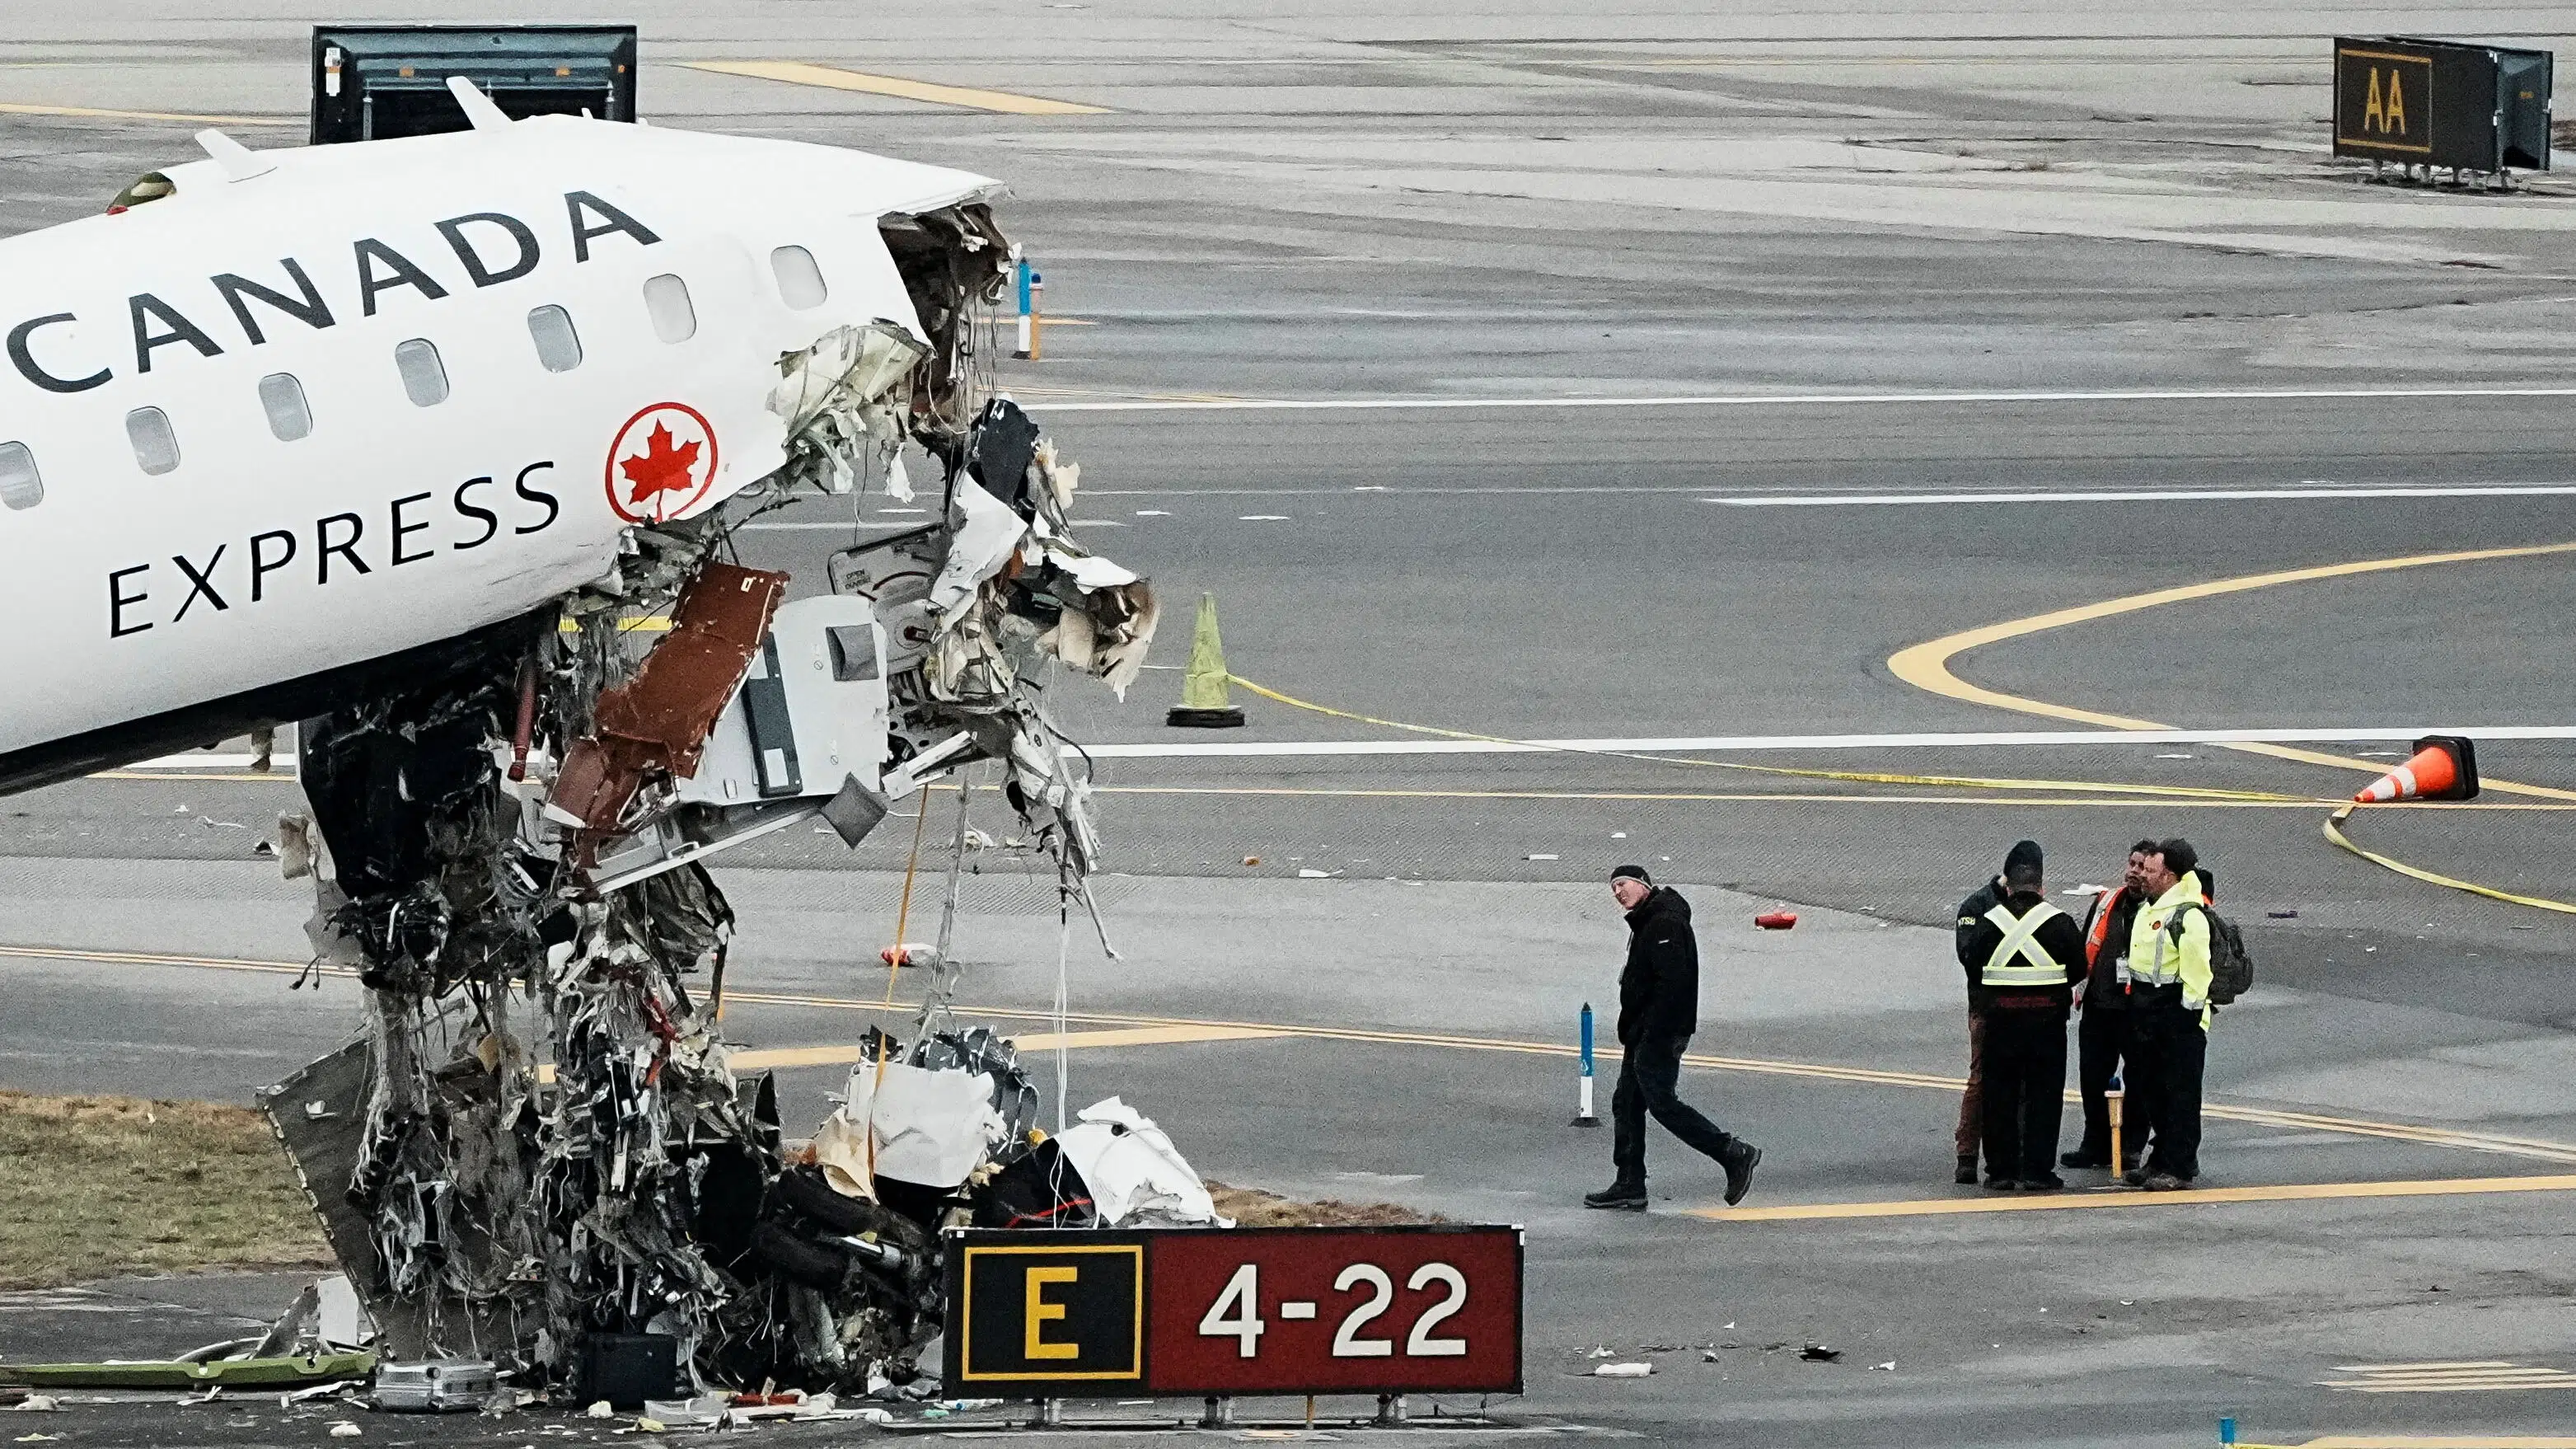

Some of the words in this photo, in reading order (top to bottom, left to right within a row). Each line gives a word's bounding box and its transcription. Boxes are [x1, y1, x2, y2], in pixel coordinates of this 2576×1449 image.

[2364, 67, 2405, 134] AA
[6, 190, 663, 393] CANADA
[109, 461, 560, 639] EXPRESS
[1024, 1266, 1080, 1360] E
[1199, 1263, 1468, 1358] 4-22
